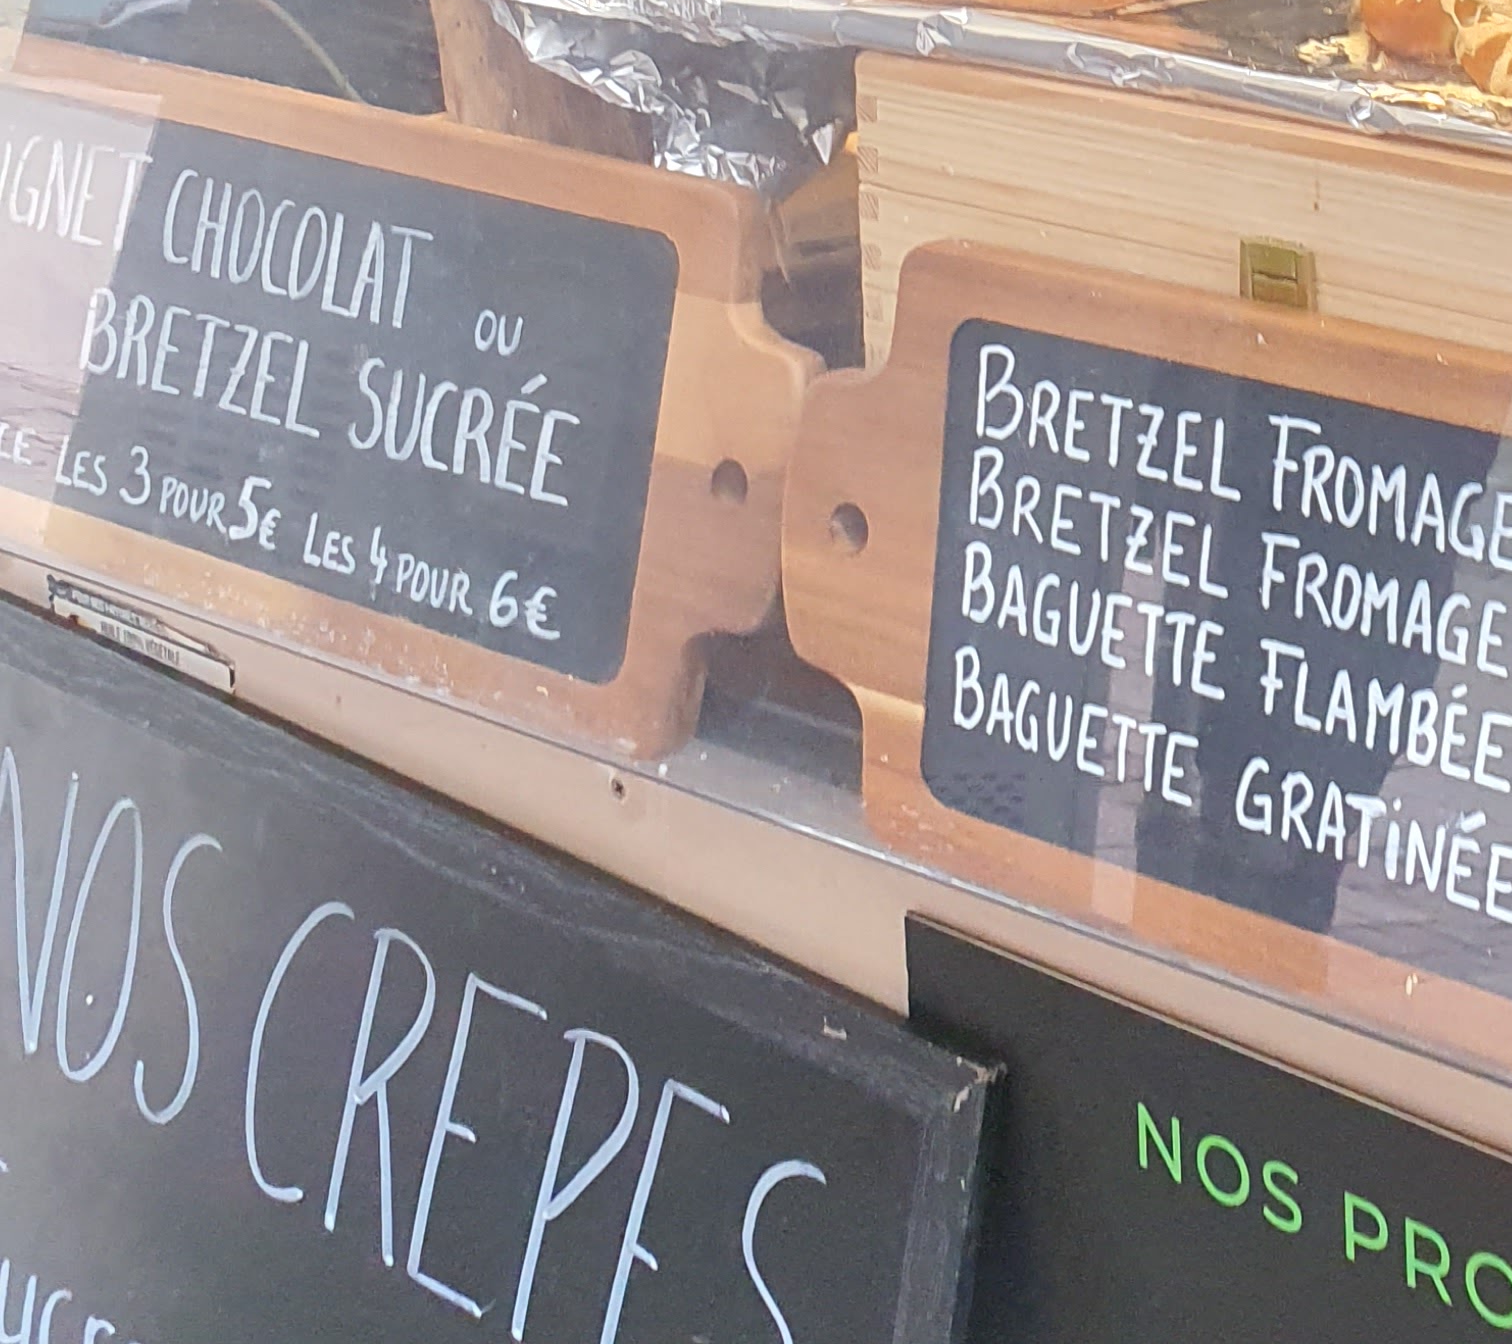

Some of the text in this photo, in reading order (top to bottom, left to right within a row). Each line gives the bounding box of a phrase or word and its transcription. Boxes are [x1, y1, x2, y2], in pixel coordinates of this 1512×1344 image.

[164, 168, 433, 329] CHOCOLAT
[80, 288, 580, 507] BRETZEL SUCRÉE
[975, 344, 1240, 502] BRETZEL
[55, 434, 108, 496] LES
[118, 445, 151, 506] 3
[159, 476, 226, 528] POUR
[303, 512, 356, 576] LES
[369, 526, 388, 583] 4
[395, 552, 473, 615] POUR
[488, 570, 561, 641] 6€
[968, 446, 1228, 598] BRETZEL
[961, 542, 1225, 701] BAGUETTE
[953, 645, 1200, 808] BAGUETTE
[0, 746, 827, 1344] NOS CREPES
[1136, 1100, 1303, 1234] NOS
